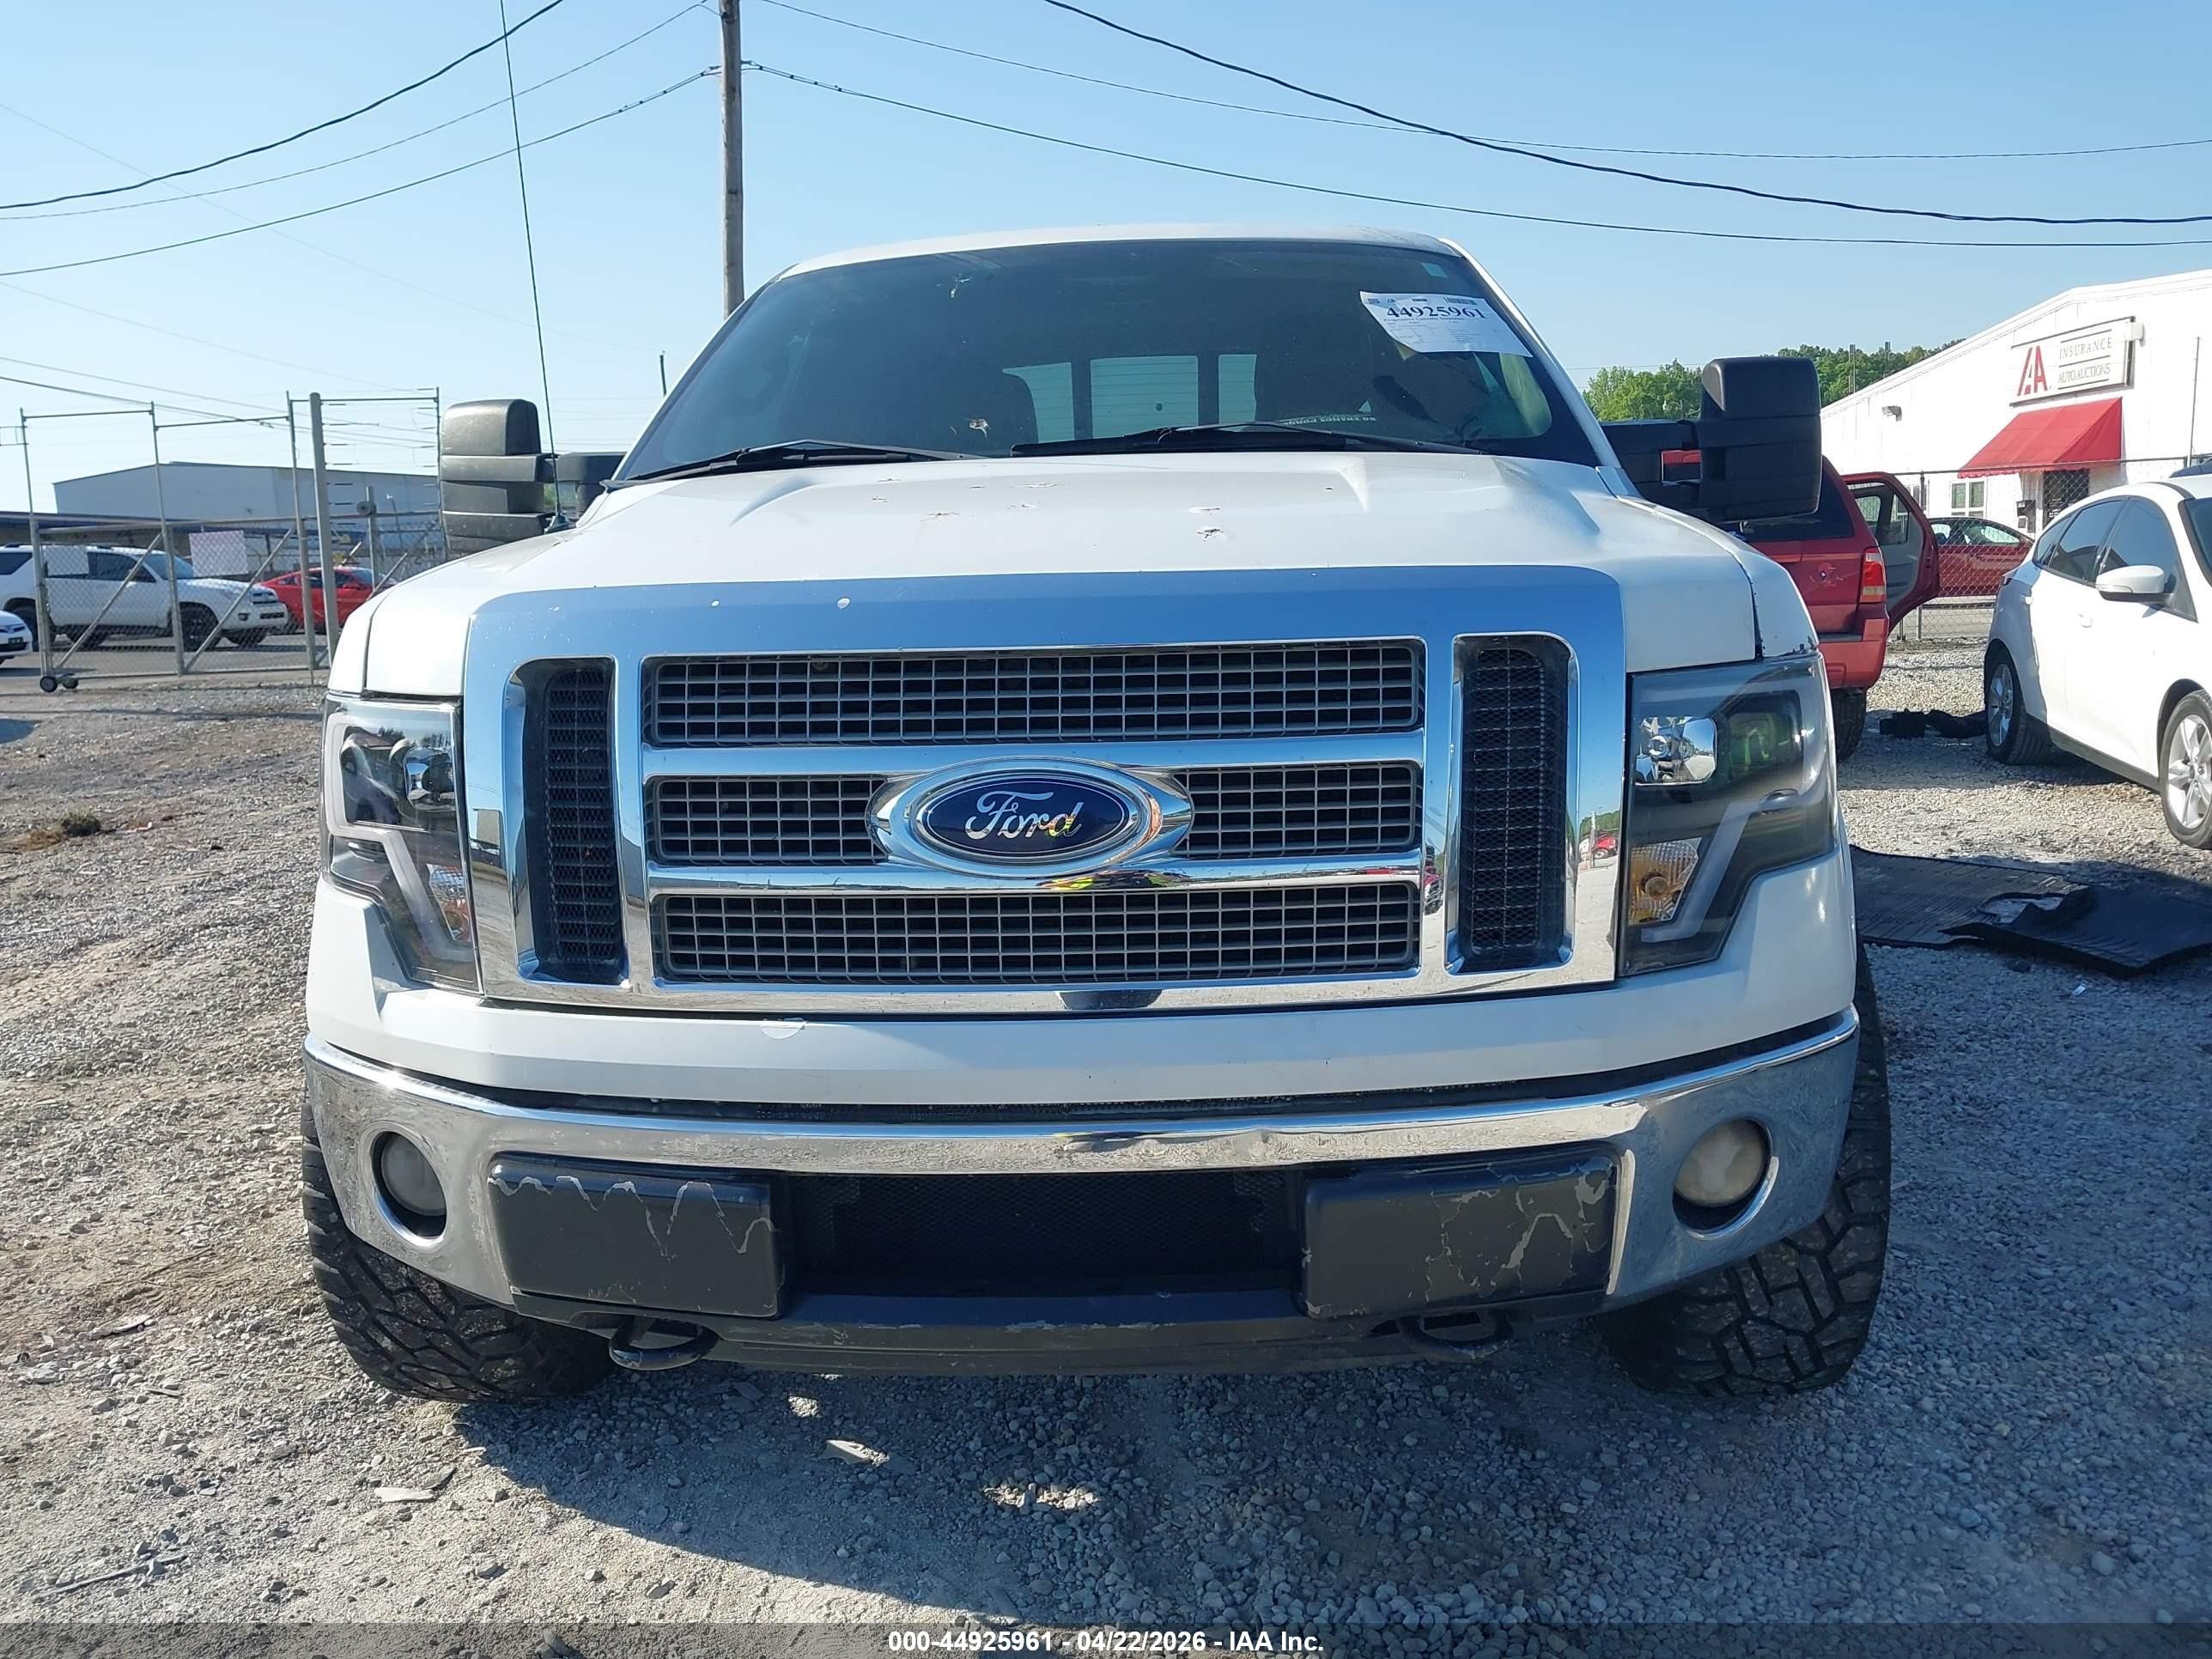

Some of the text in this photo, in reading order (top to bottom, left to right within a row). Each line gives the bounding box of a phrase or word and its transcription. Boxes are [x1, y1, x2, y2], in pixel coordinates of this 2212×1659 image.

[1387, 306, 1486, 319] 44925961
[2059, 337, 2112, 359] INSURANCE
[965, 790, 1085, 840] Ford
